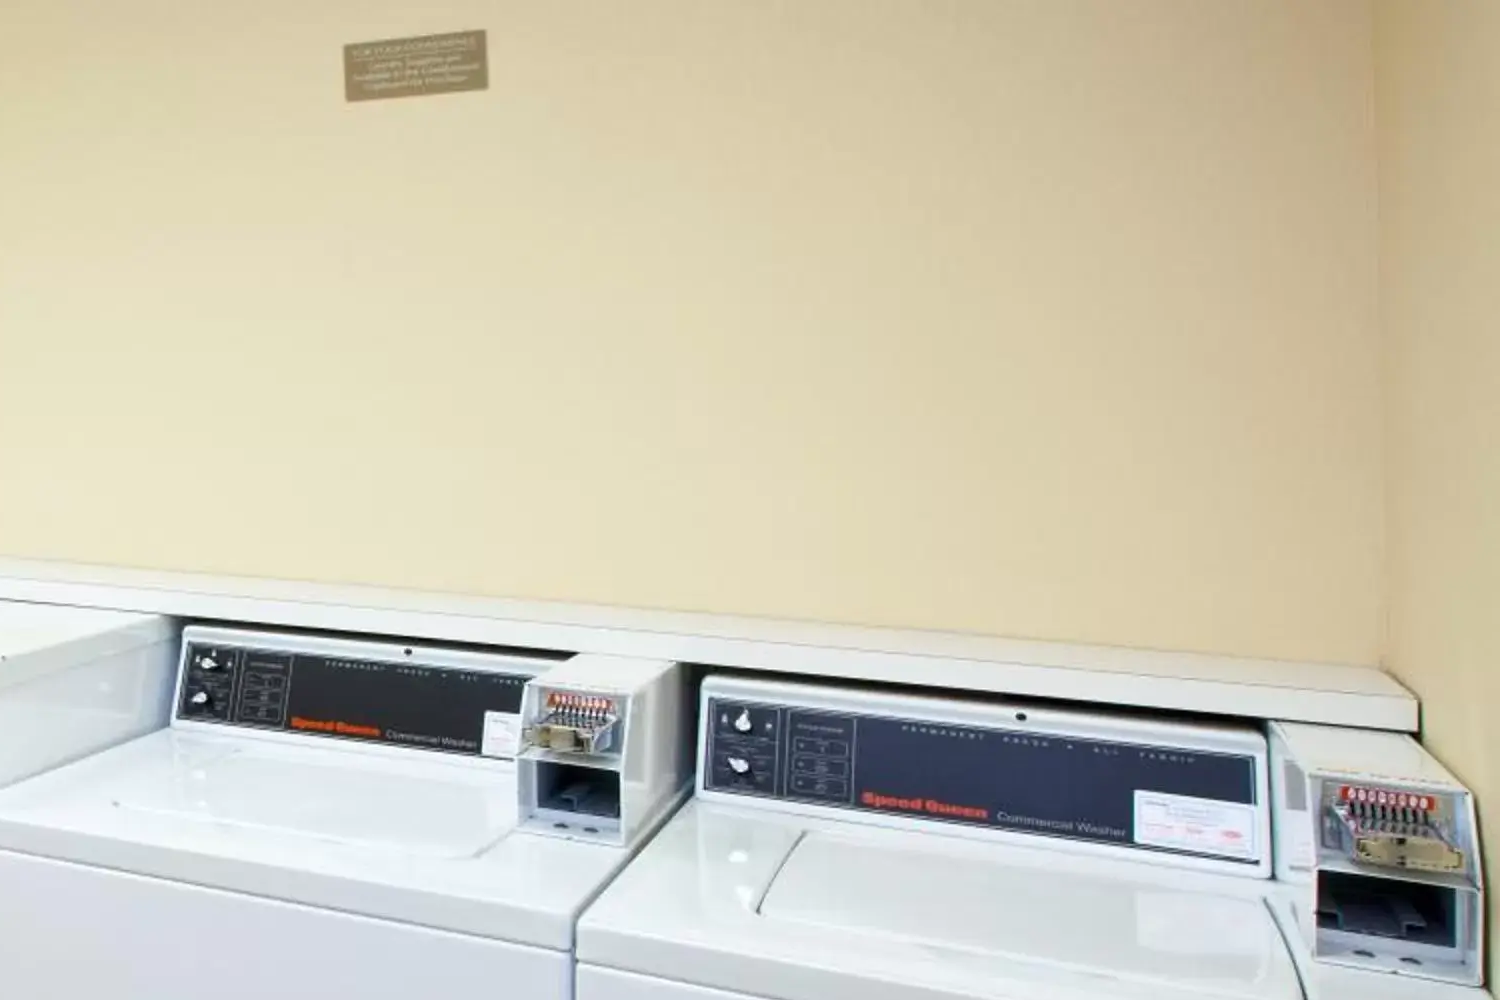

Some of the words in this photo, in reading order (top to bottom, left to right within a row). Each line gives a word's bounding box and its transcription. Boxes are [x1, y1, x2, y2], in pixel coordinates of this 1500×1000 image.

[386, 728, 440, 745] Commercial
[861, 791, 922, 811] Speed
[925, 798, 989, 819] Queen
[997, 810, 1074, 831] Commercial
[1077, 817, 1127, 838] Washer
